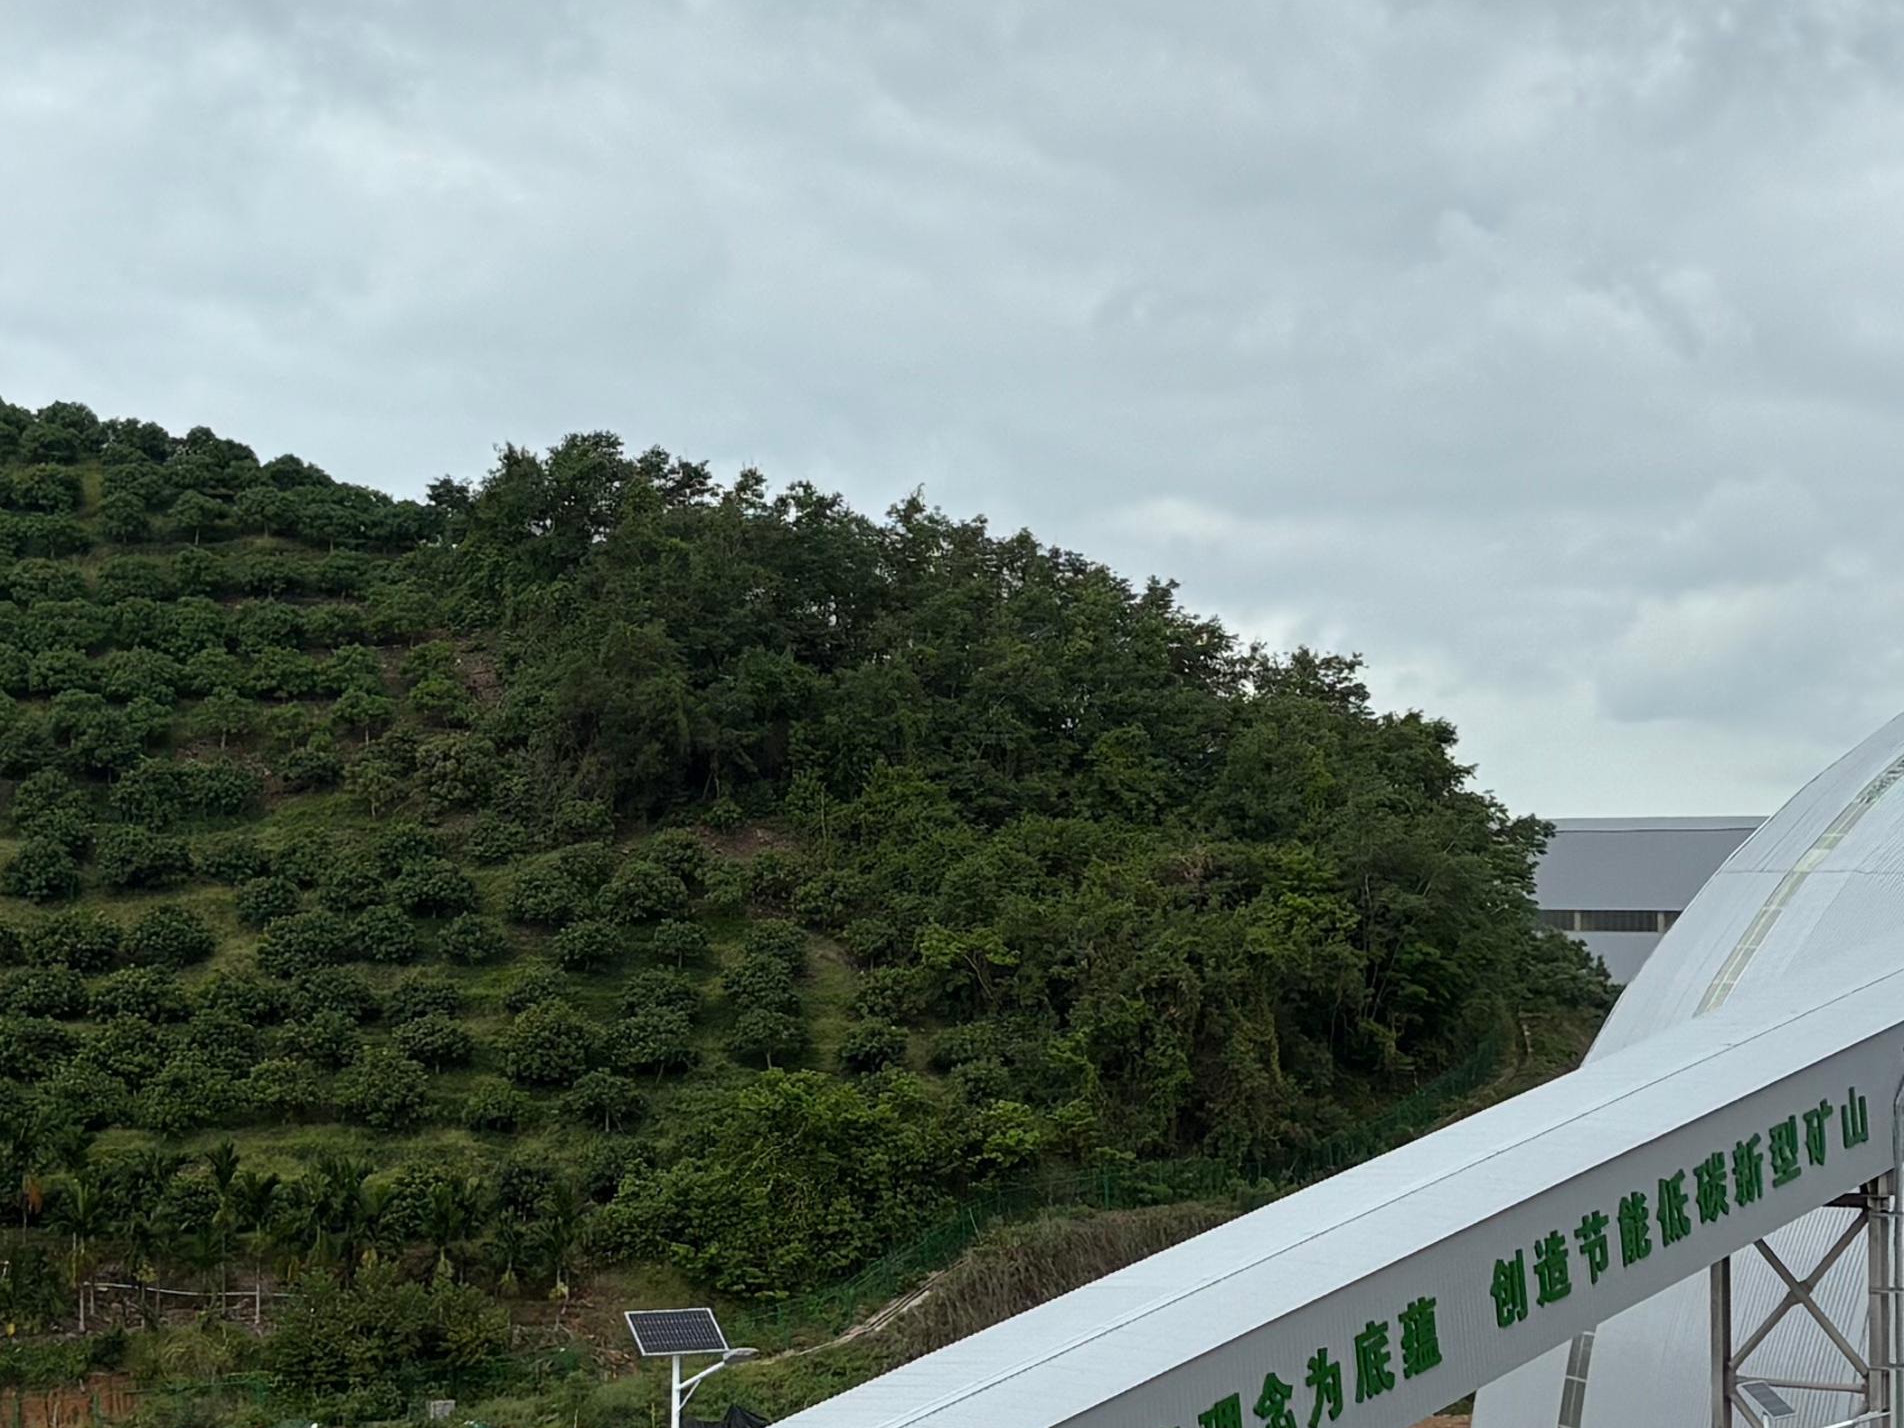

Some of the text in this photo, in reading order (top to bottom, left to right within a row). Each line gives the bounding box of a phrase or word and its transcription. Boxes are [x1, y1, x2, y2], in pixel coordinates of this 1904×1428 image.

[1490, 1086, 1868, 1328] 创造节能低碳新型矿山
